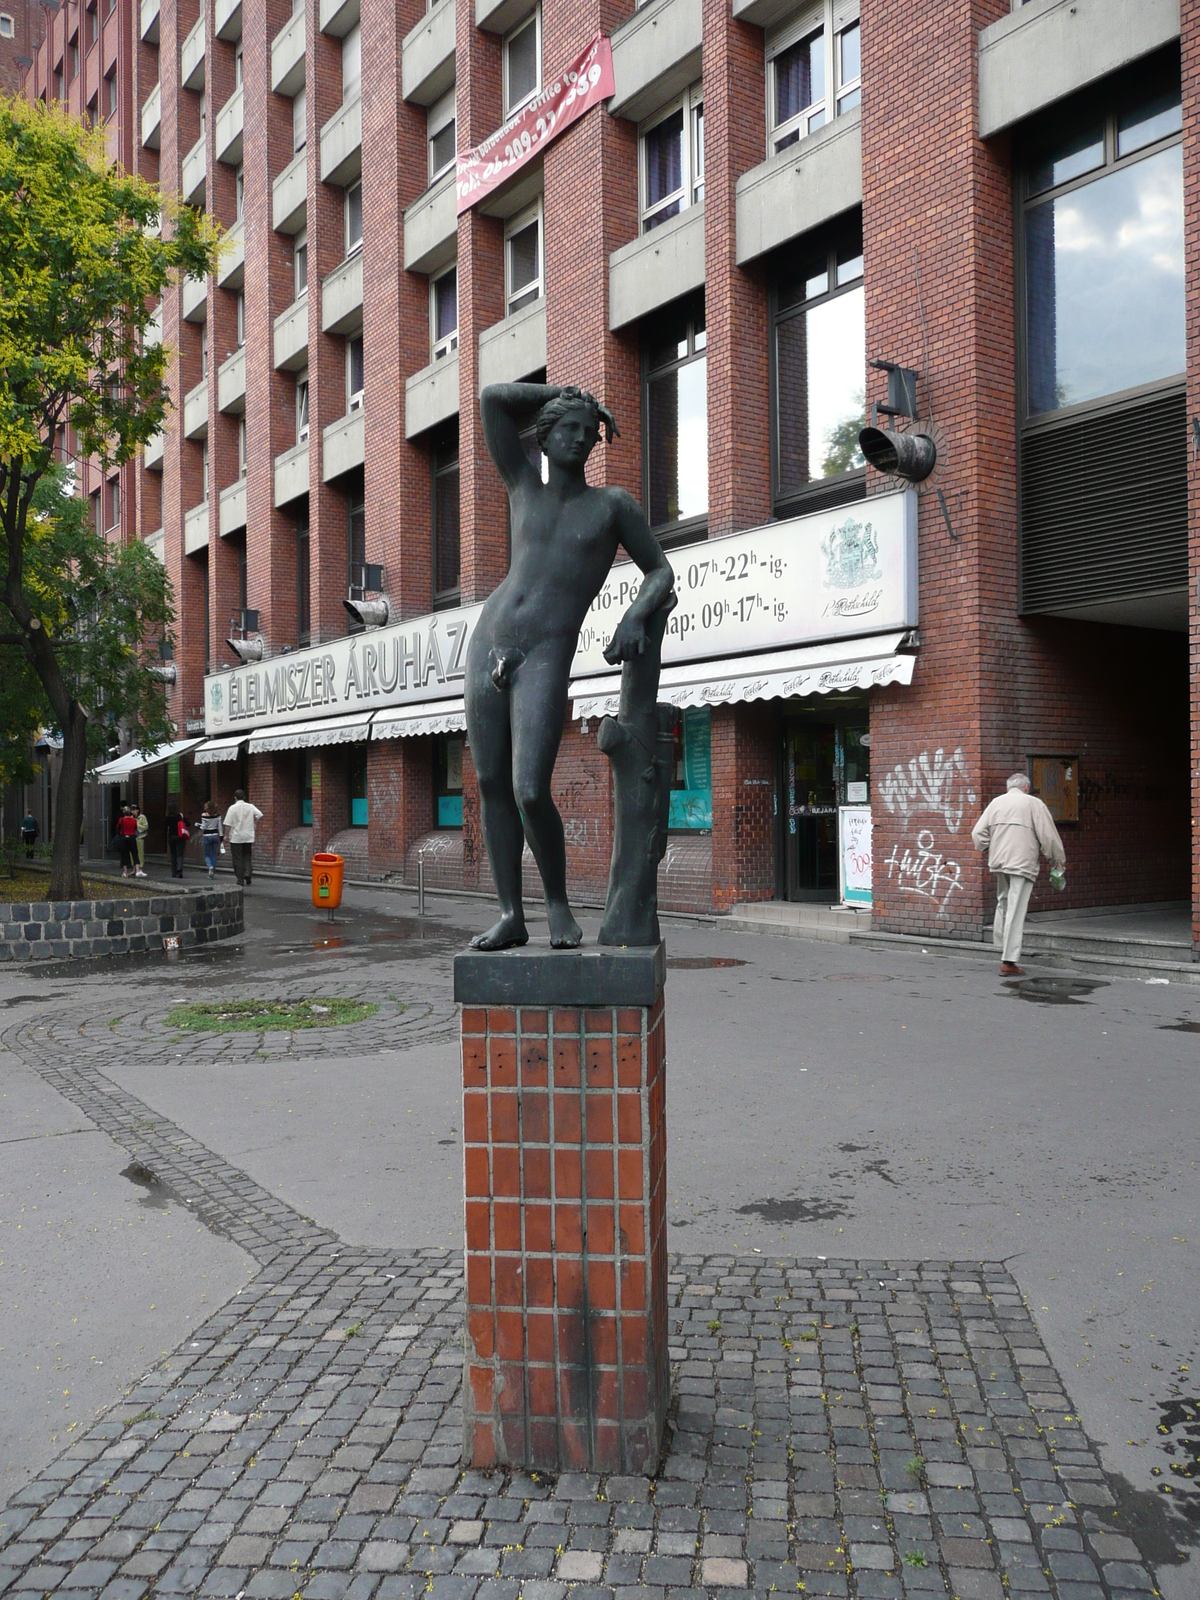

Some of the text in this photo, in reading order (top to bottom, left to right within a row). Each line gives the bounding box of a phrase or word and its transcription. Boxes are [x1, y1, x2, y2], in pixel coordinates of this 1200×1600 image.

[563, 71, 578, 86] to
[228, 614, 467, 721] ÉLELMISZER ÁRUHÁZ
